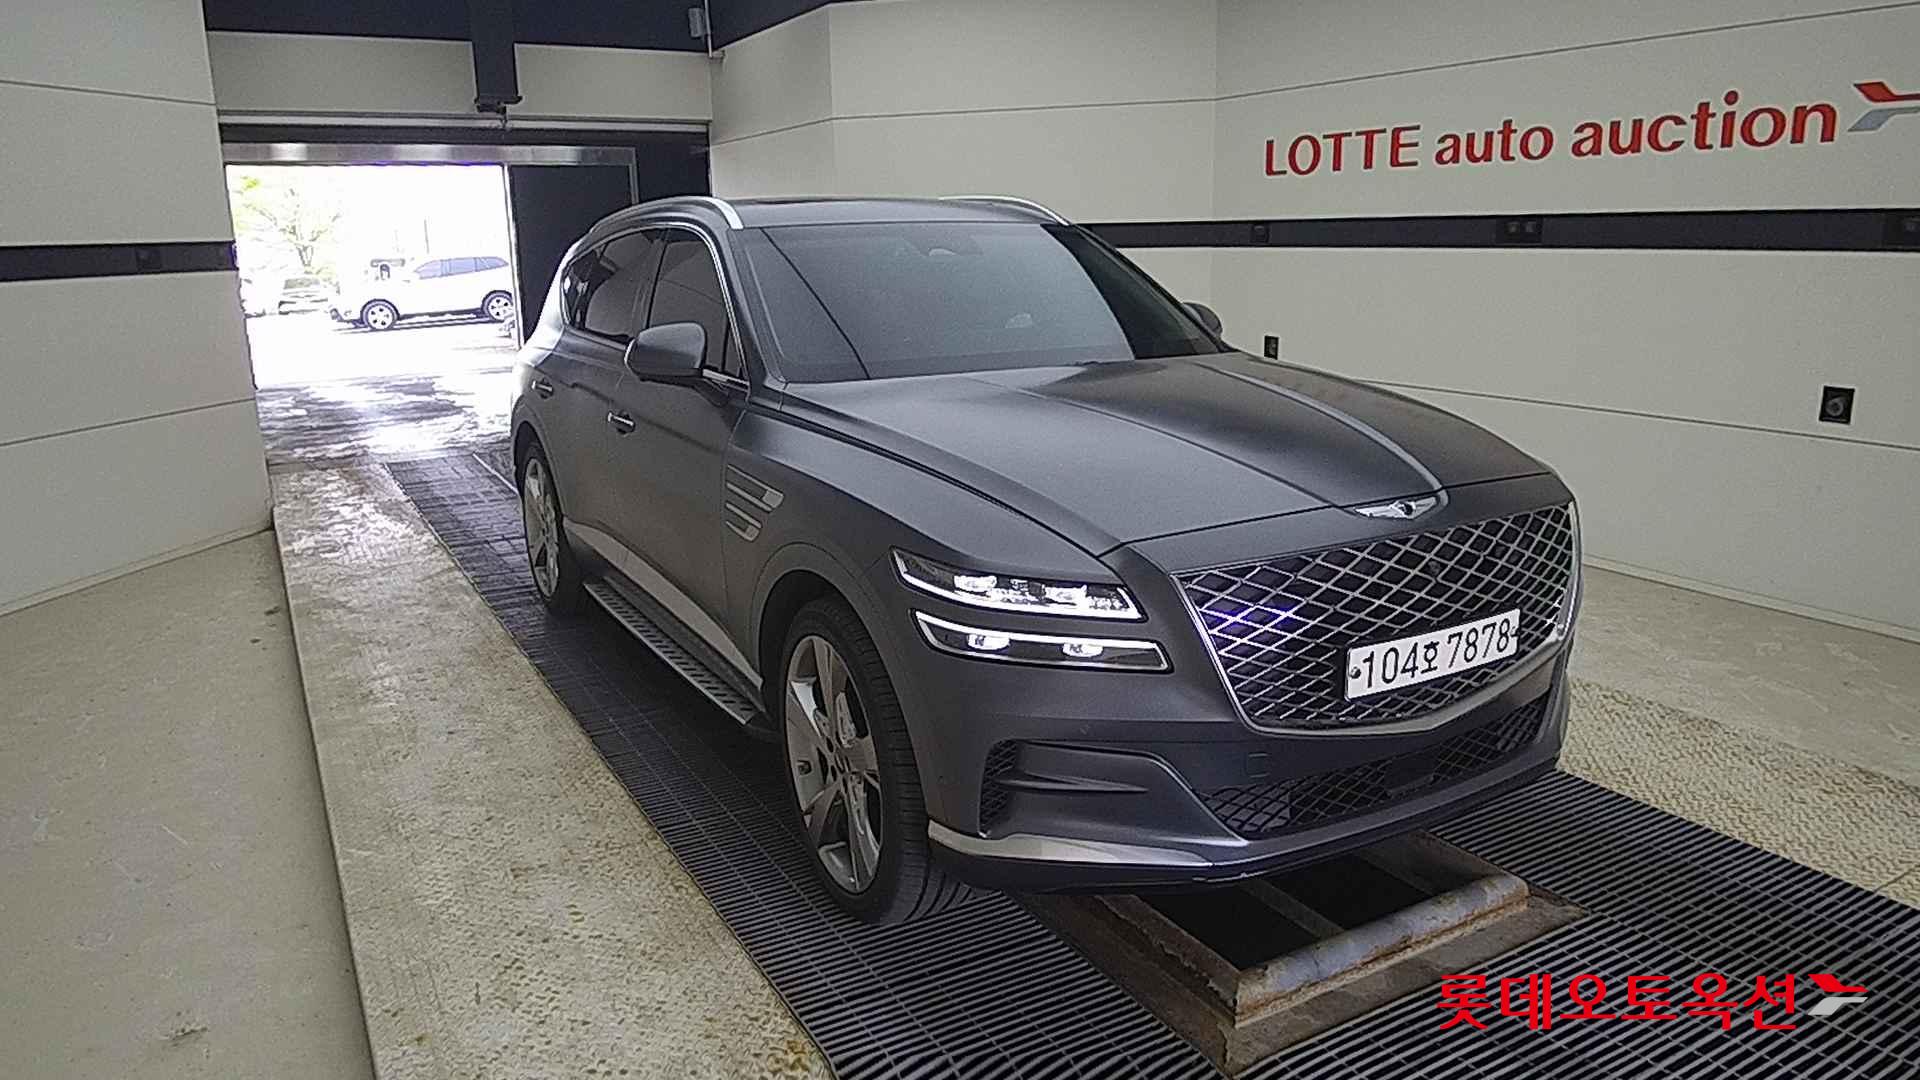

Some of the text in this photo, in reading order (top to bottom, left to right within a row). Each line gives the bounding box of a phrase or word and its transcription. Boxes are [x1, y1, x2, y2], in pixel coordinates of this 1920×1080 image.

[1265, 90, 1839, 176] LOTTE auto auction
[1362, 617, 1511, 688] 104호 7878
